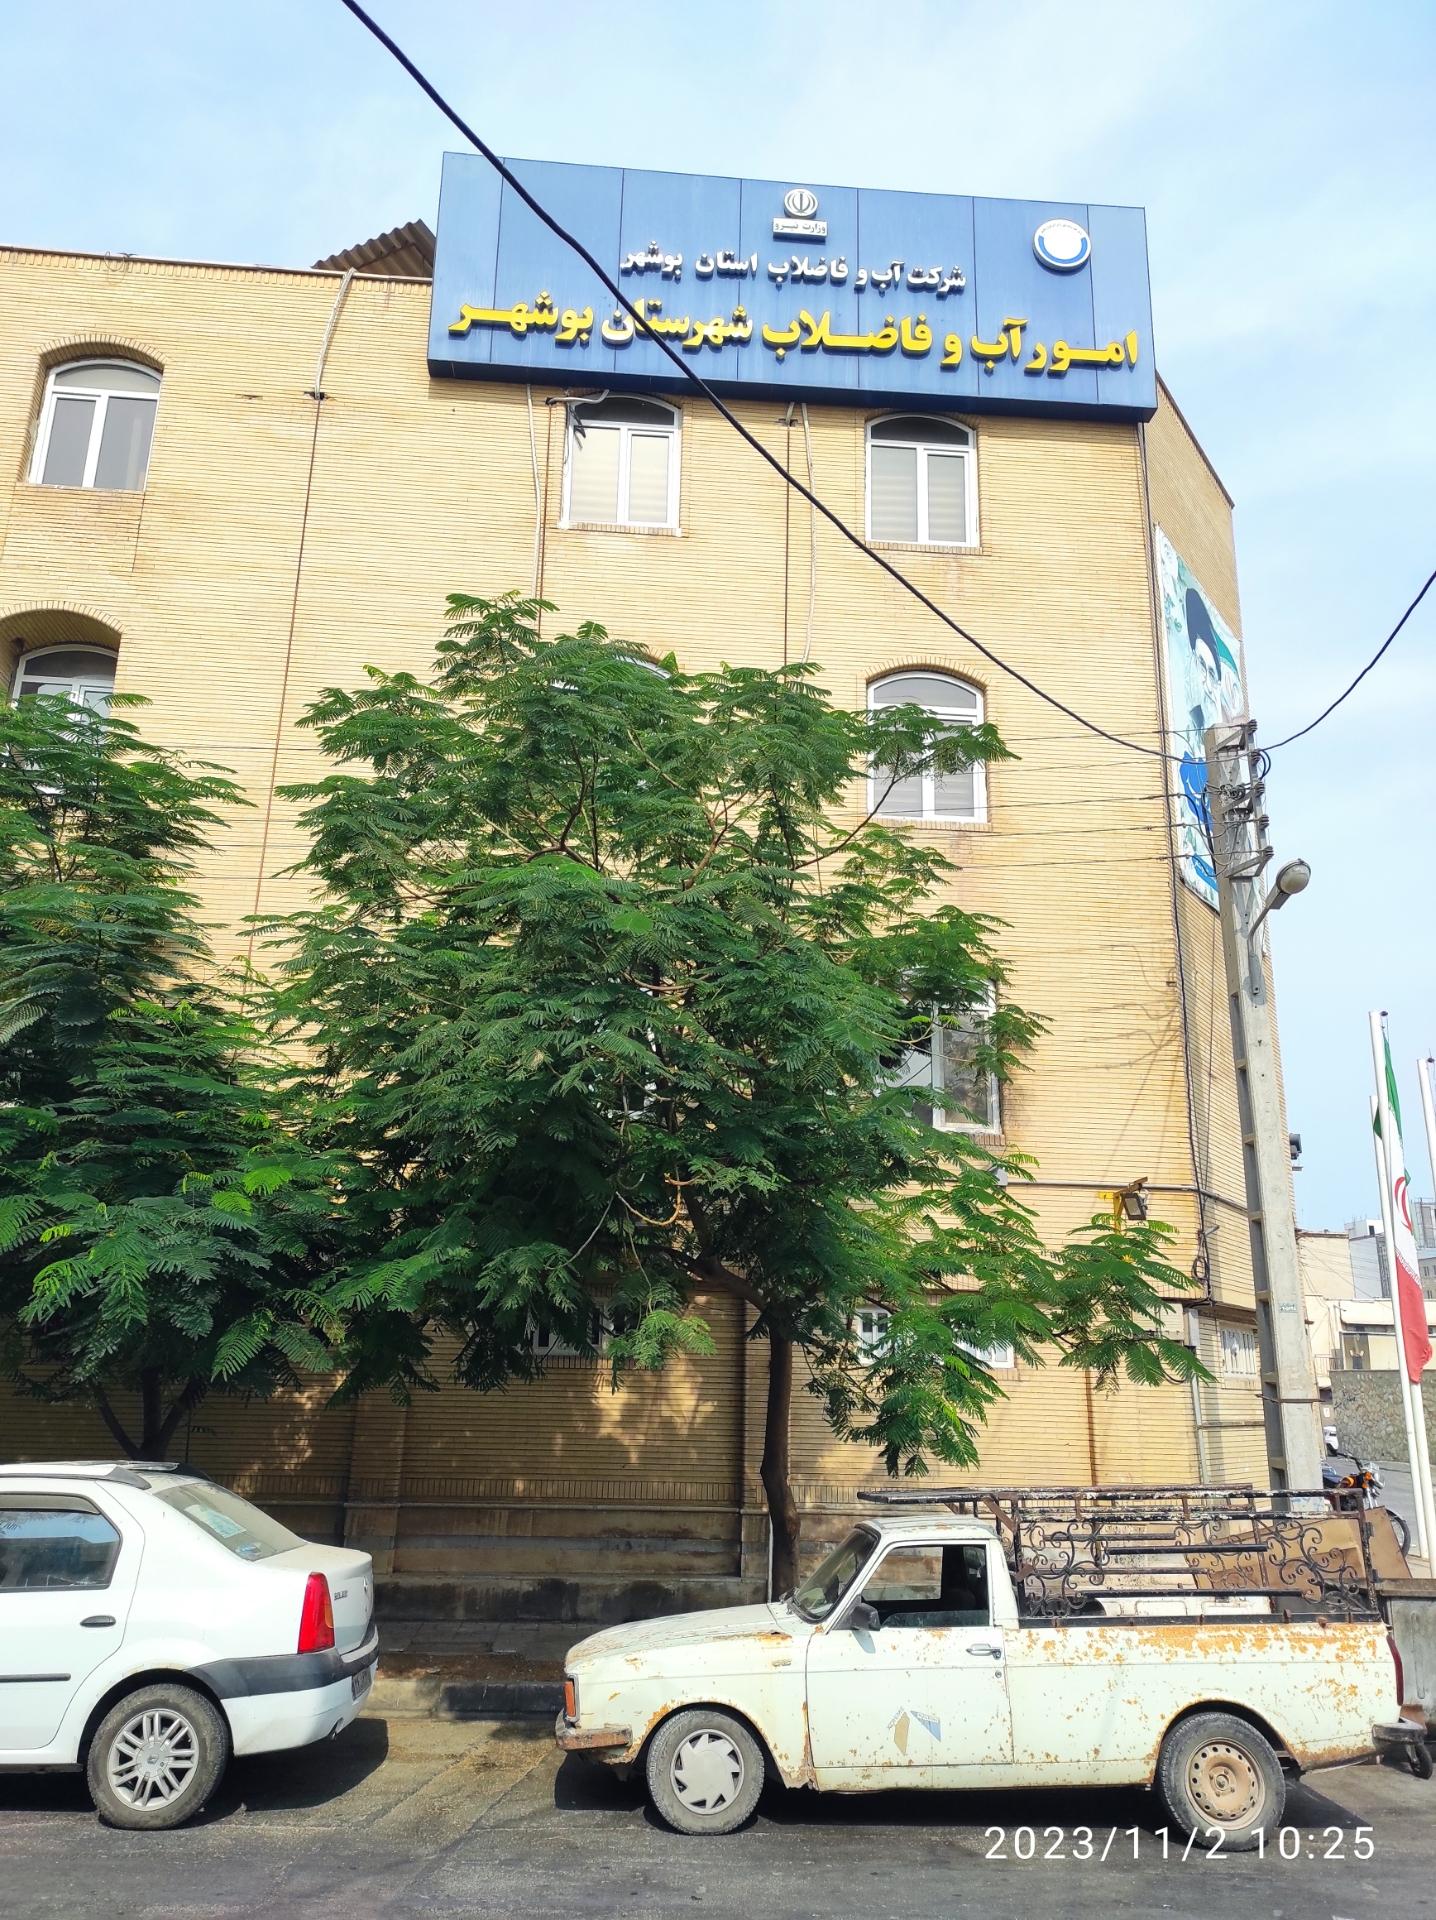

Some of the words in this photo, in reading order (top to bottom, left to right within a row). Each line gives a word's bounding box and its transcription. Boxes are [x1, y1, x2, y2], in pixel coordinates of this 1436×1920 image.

[775, 222, 799, 232] نیرو
[802, 222, 826, 234] وزارت
[620, 240, 683, 276] بوشهر
[695, 251, 758, 275] استان
[767, 255, 849, 283] فاضلاب
[855, 267, 868, 286] و
[871, 261, 904, 291] آب
[907, 265, 966, 293] شرکت
[448, 289, 595, 344] بوشهر
[601, 297, 754, 347] شهرستان
[762, 310, 933, 359] فاضلاب
[941, 332, 963, 366] و
[970, 317, 1027, 371] آب
[1025, 329, 1139, 374] امور
